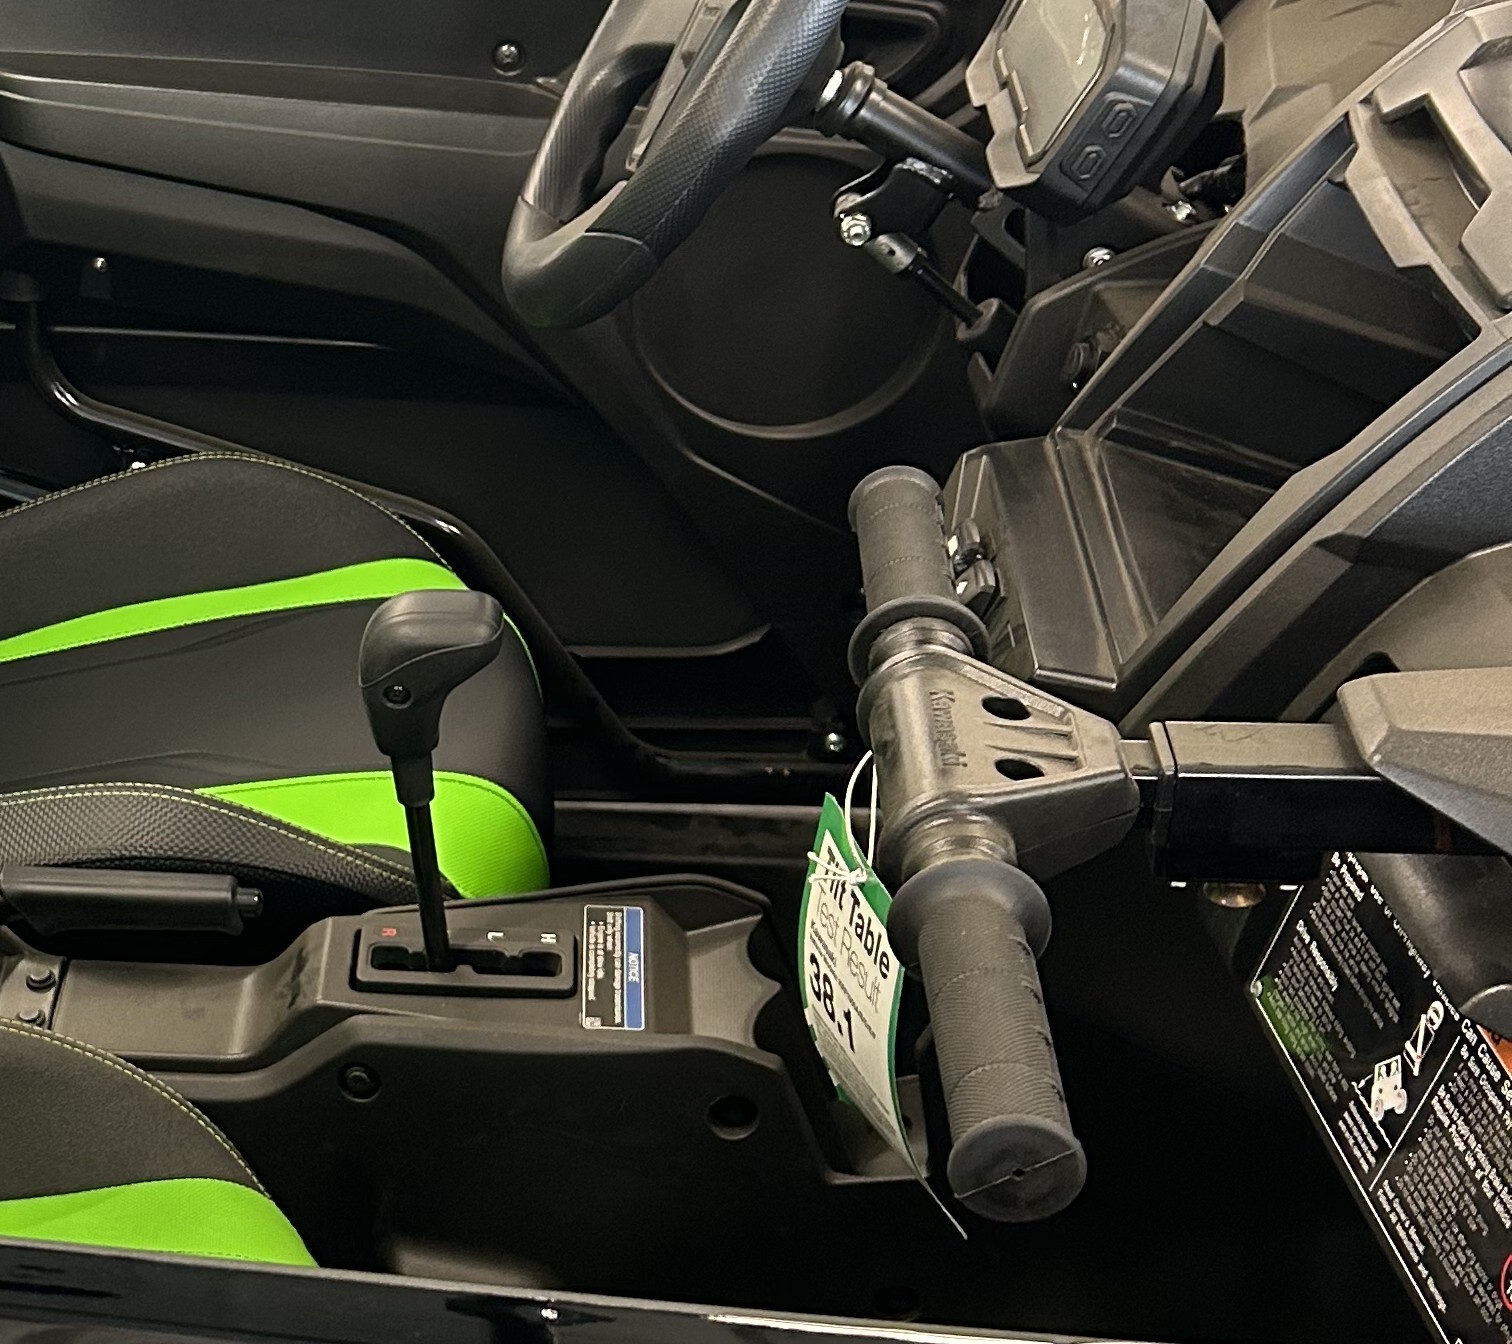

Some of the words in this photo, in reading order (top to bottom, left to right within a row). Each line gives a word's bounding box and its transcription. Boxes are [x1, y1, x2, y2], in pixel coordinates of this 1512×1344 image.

[381, 927, 397, 938] R
[488, 931, 504, 941] L
[540, 932, 557, 944] H
[628, 951, 639, 984] NOTICE
[816, 879, 841, 943] Test
[840, 931, 883, 1015] Result
[849, 888, 890, 980] Table
[809, 952, 856, 1054] 38.1
[1461, 1018, 1478, 1047] Can
[1477, 1043, 1502, 1083] Cause
[1500, 1079, 1512, 1106] Se
